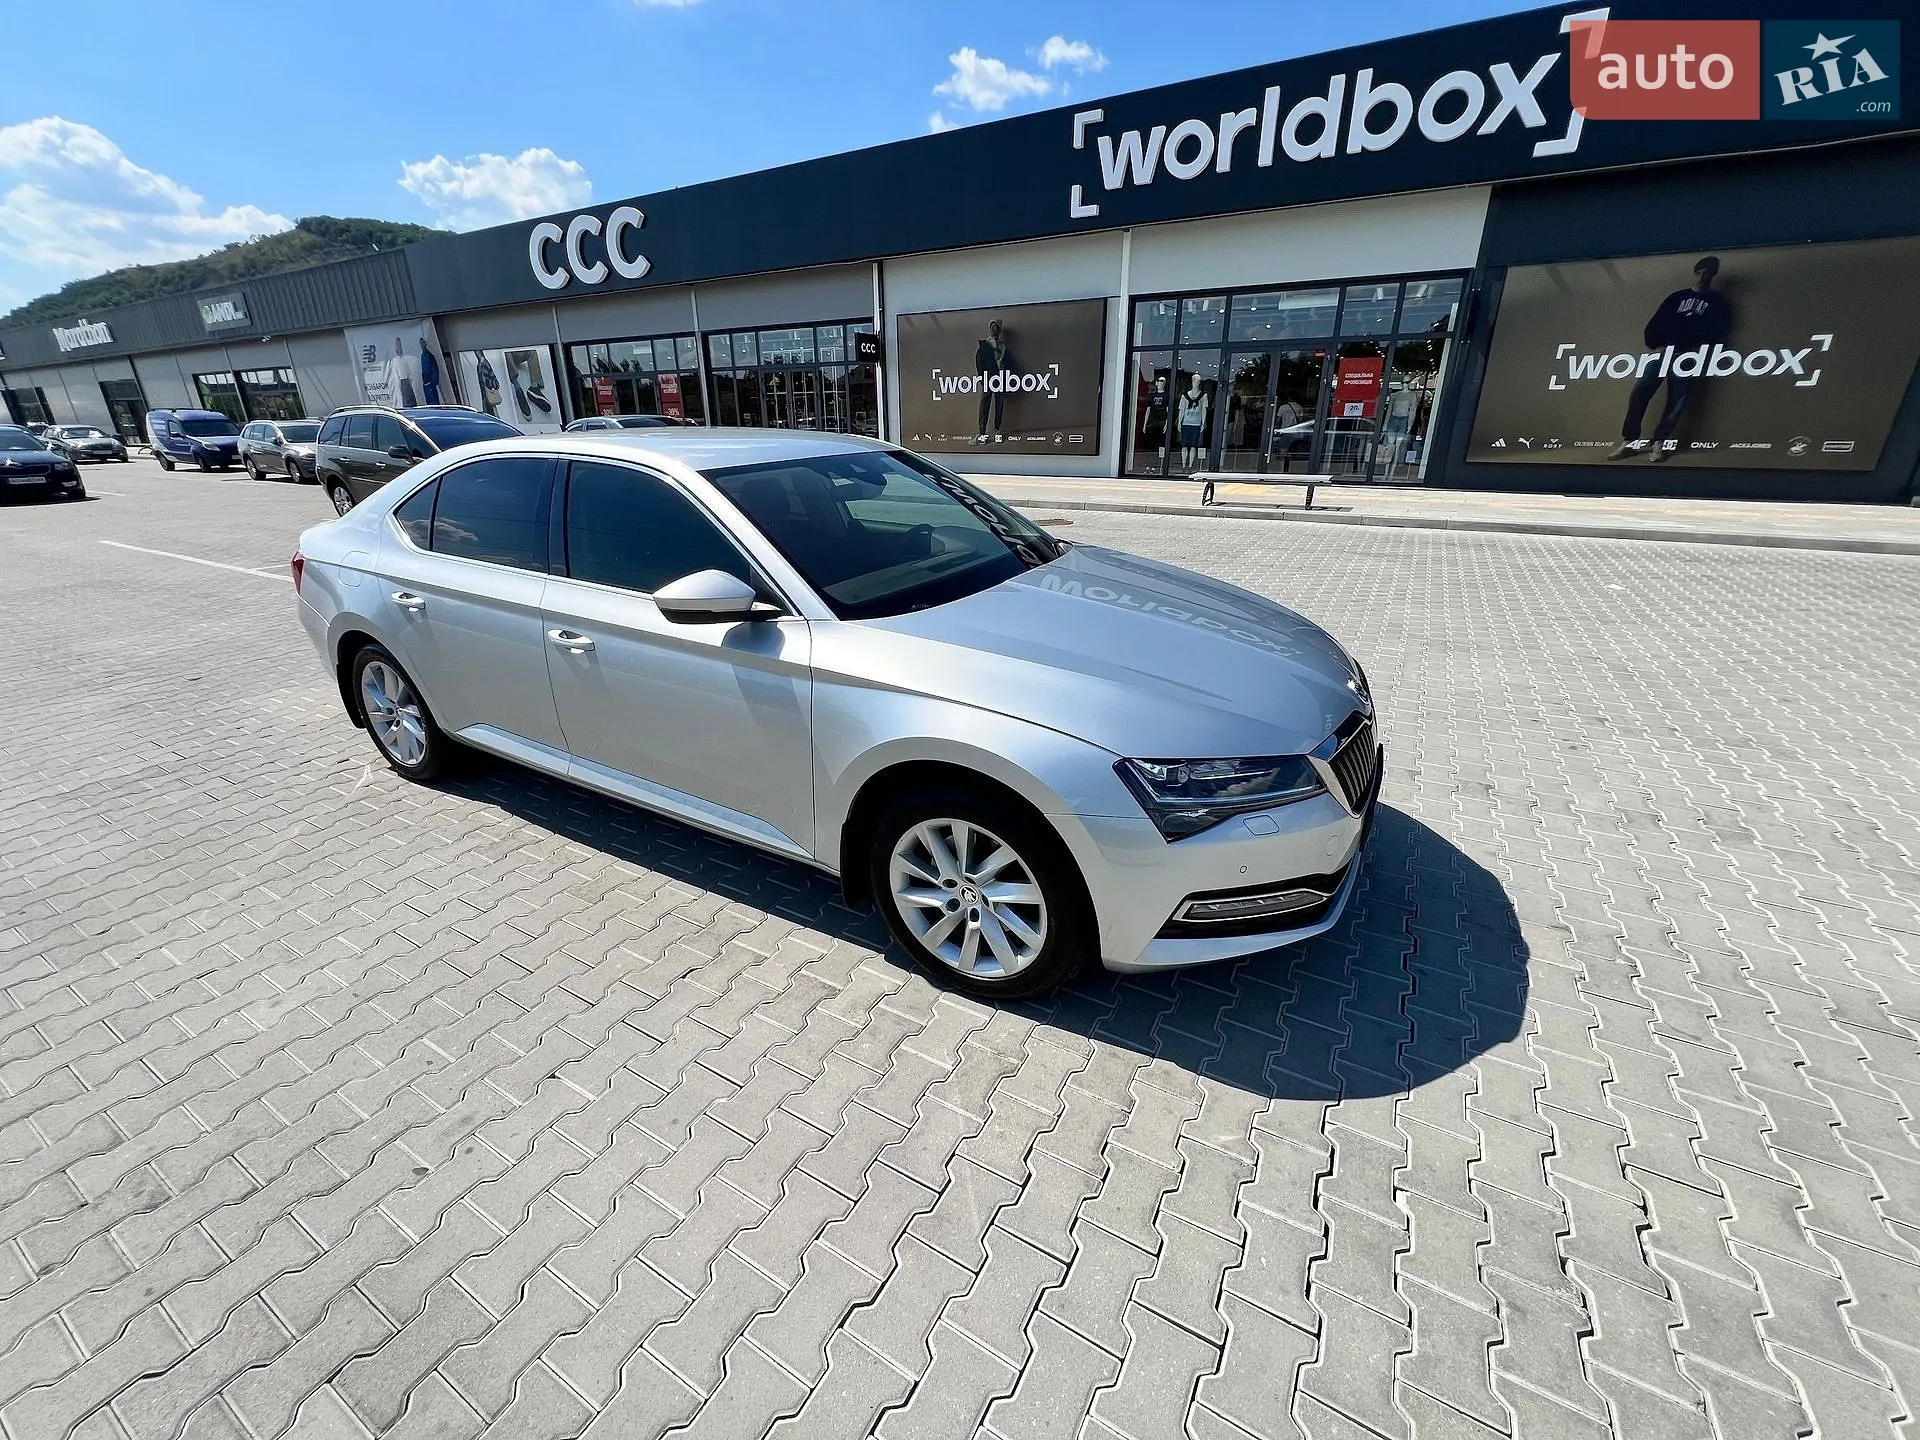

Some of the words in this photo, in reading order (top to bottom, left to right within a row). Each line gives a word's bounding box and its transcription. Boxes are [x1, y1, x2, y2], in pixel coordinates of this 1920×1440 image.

[1097, 52, 1561, 191] worldbox
[529, 206, 651, 290] CCC
[861, 342, 876, 353] CCC
[1568, 344, 1813, 379] worldbox
[939, 370, 1051, 394] worldbox
[1691, 441, 1719, 449] ONLY
